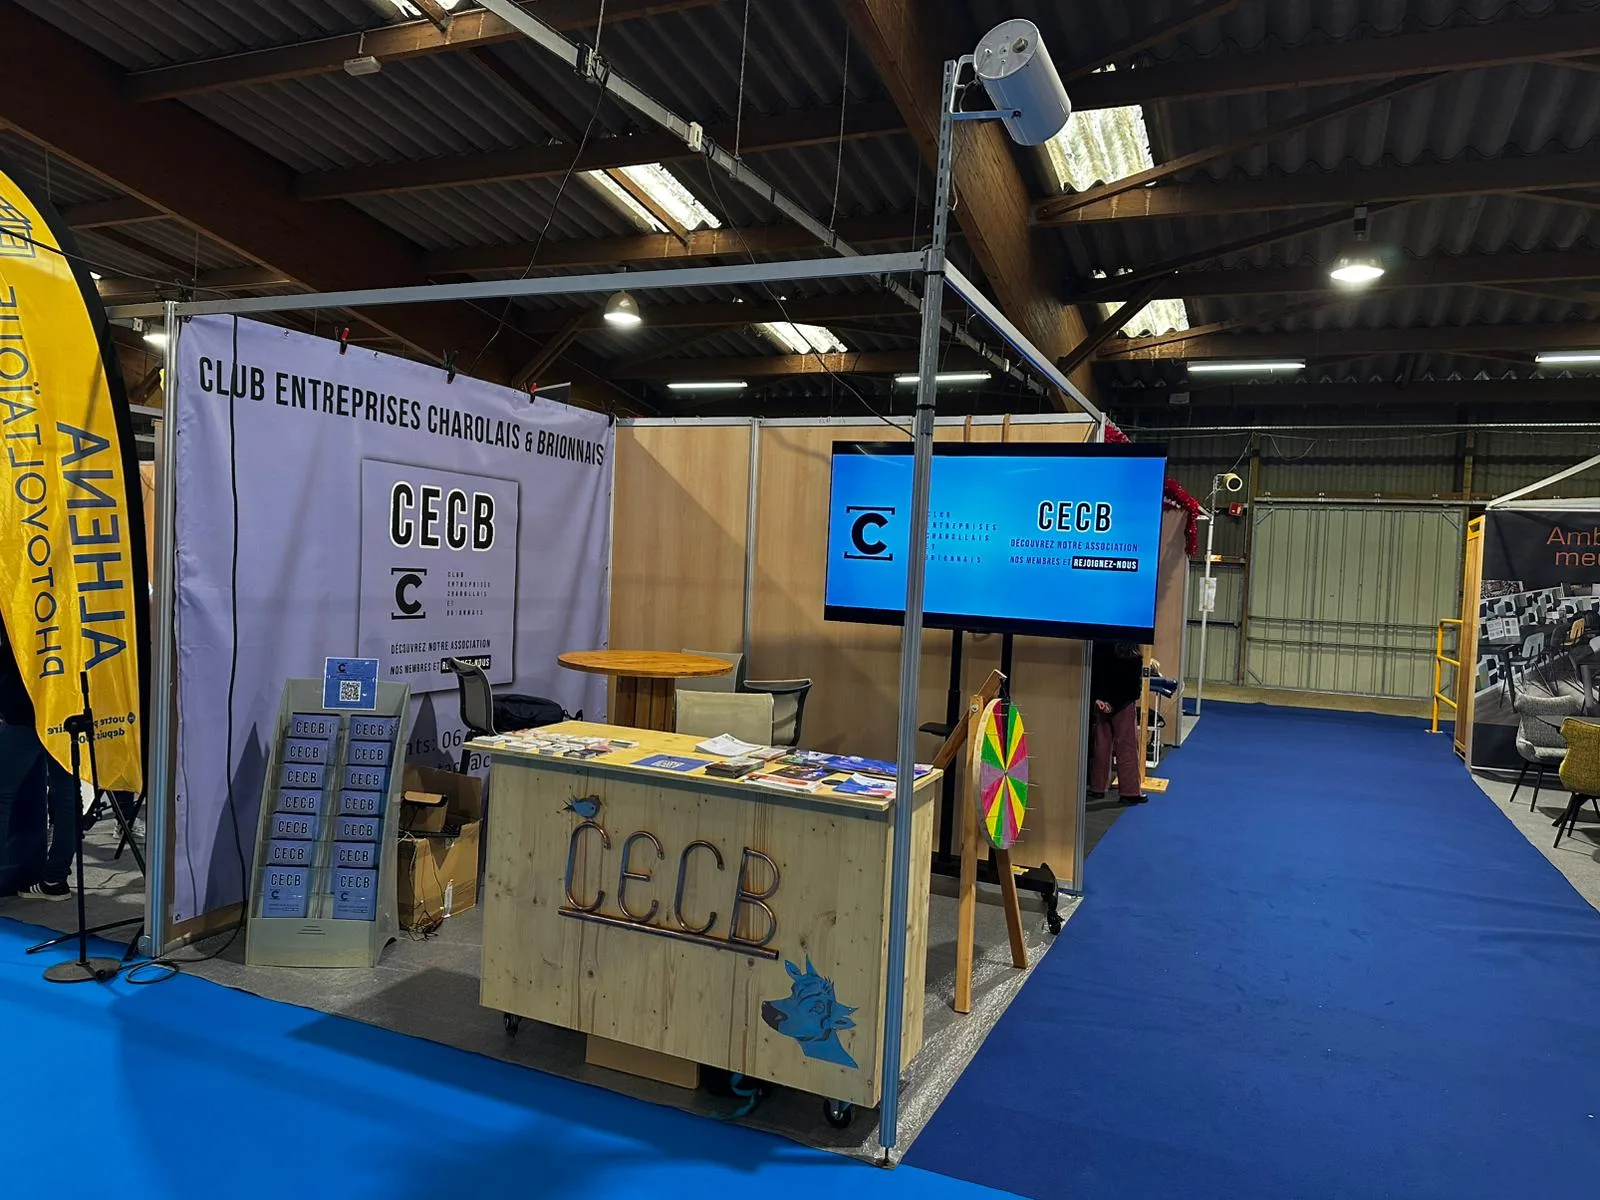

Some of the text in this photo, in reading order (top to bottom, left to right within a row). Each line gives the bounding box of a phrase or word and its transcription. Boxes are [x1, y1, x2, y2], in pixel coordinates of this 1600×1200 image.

[199, 356, 604, 466] CLUB ENTREPRISES CHAROLAIS & BRIONNAIS
[389, 481, 496, 552] CECB
[1037, 500, 1112, 533] CECB
[851, 512, 889, 555] C
[1010, 537, 1138, 552] DÉCOUVREZ NOTRE ASSOCIATION
[1009, 556, 1137, 570] NOS MEMBRES ET REJOIGNEZ-NOUS
[395, 573, 423, 615] C
[428, 641, 449, 651] NOTRE
[450, 639, 490, 650] ASSOCIATION
[296, 721, 325, 734] CECB
[355, 724, 384, 736] CECB
[290, 746, 319, 758] CECB
[354, 748, 384, 760] CECB
[287, 771, 317, 783] CECB
[350, 773, 380, 785] CECB
[285, 796, 315, 809] CECB
[345, 798, 374, 810] CECB
[278, 821, 308, 833] CECB
[344, 824, 373, 836] CECB
[274, 848, 304, 860] CECB
[339, 850, 369, 862] CECB
[271, 873, 301, 886] CECB
[340, 876, 370, 888] CECB
[565, 821, 780, 946] CECB
